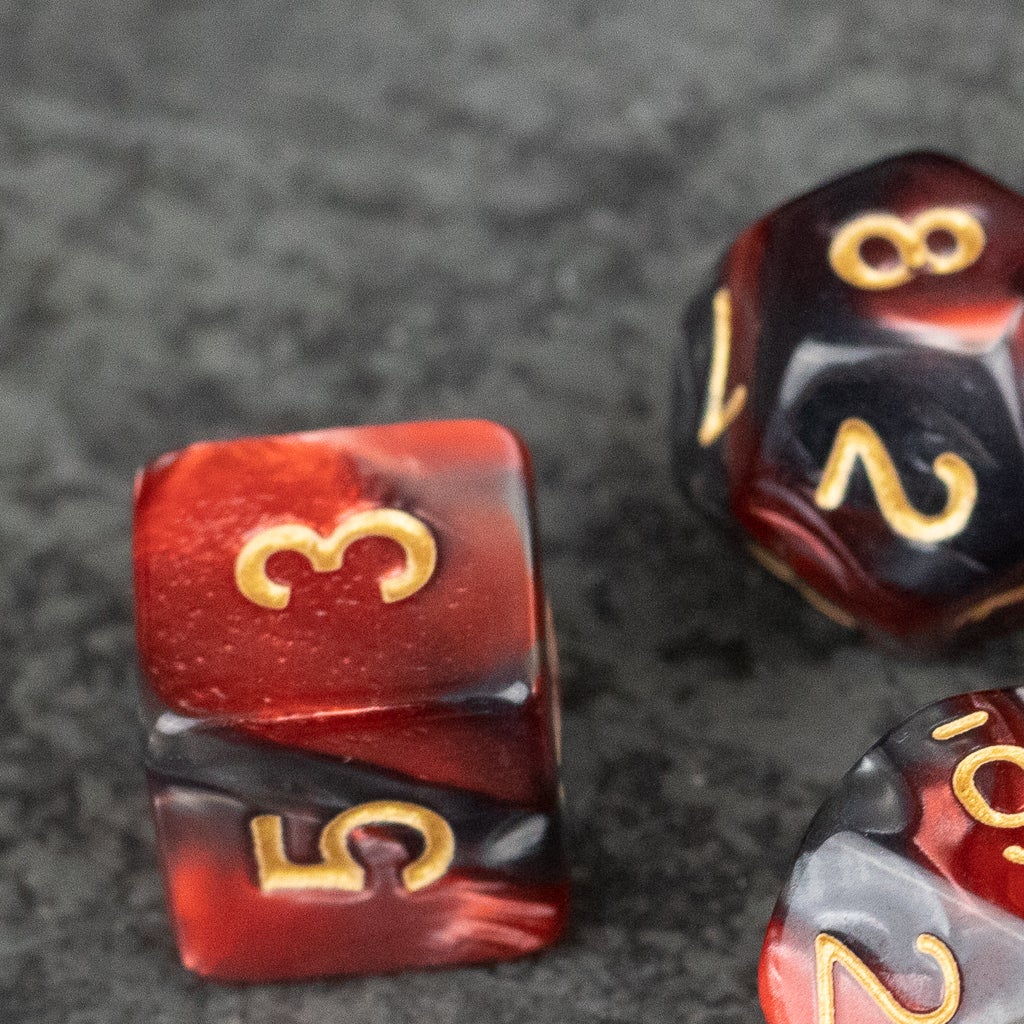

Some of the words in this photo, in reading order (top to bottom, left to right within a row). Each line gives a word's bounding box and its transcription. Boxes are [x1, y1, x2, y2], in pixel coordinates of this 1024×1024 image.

[829, 206, 986, 290] 8
[814, 417, 977, 545] 2
[235, 508, 437, 610] 3
[249, 800, 455, 893] 5
